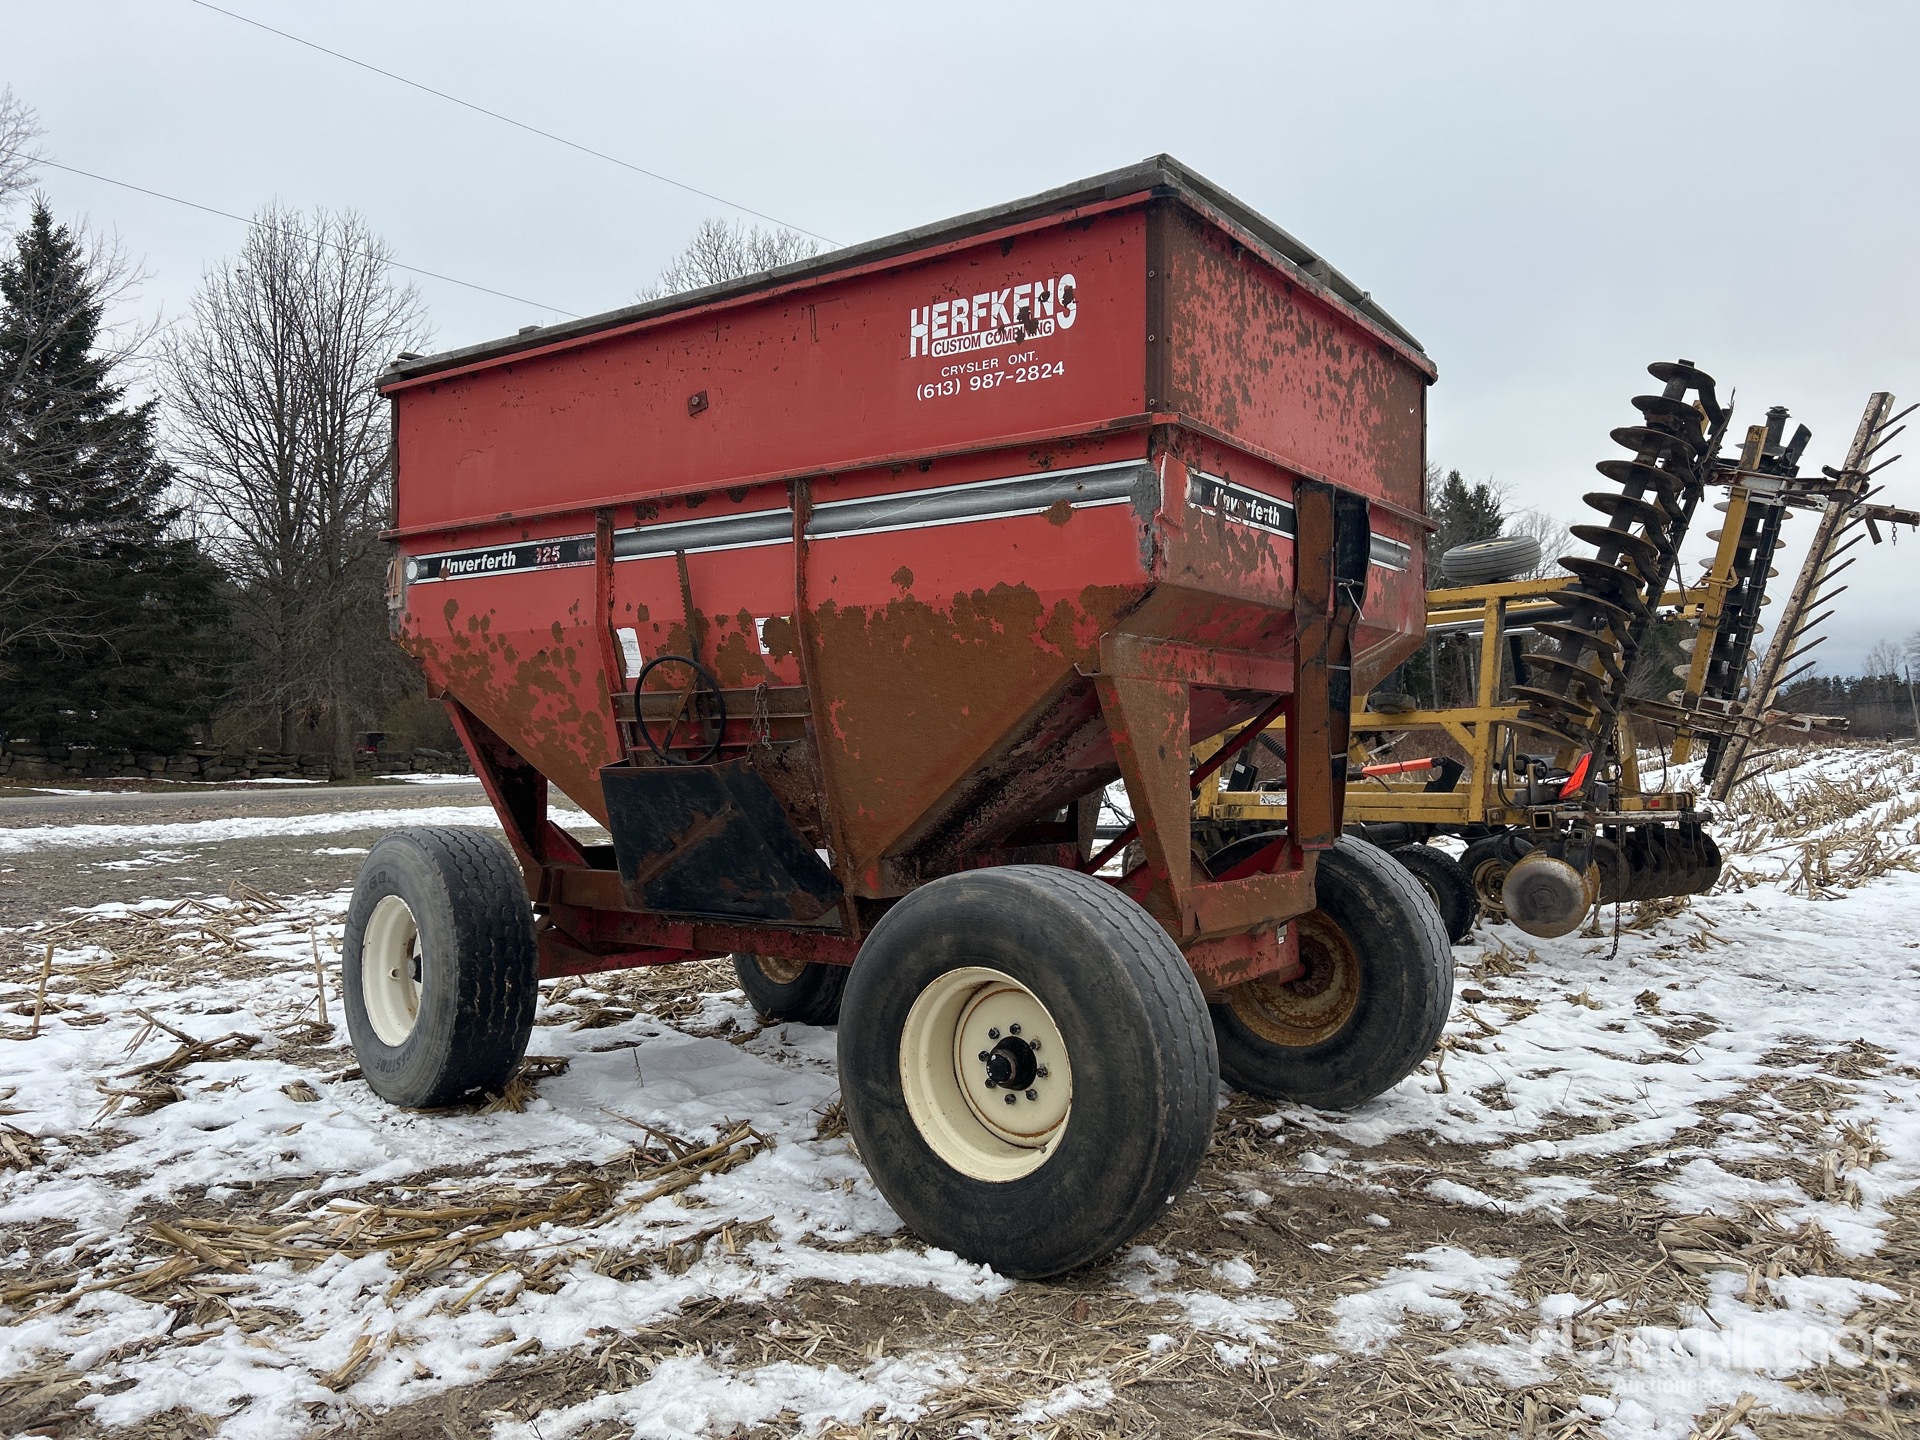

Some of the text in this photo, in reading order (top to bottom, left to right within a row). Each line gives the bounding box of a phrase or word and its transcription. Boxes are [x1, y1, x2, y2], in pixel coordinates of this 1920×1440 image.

[910, 273, 1077, 358] HERFKENS
[934, 334, 981, 355] CUSTOM
[941, 351, 1039, 377] CRYSLER ONT.
[916, 361, 1065, 401] (613) 987-2824
[1213, 486, 1280, 526] Unvrferth
